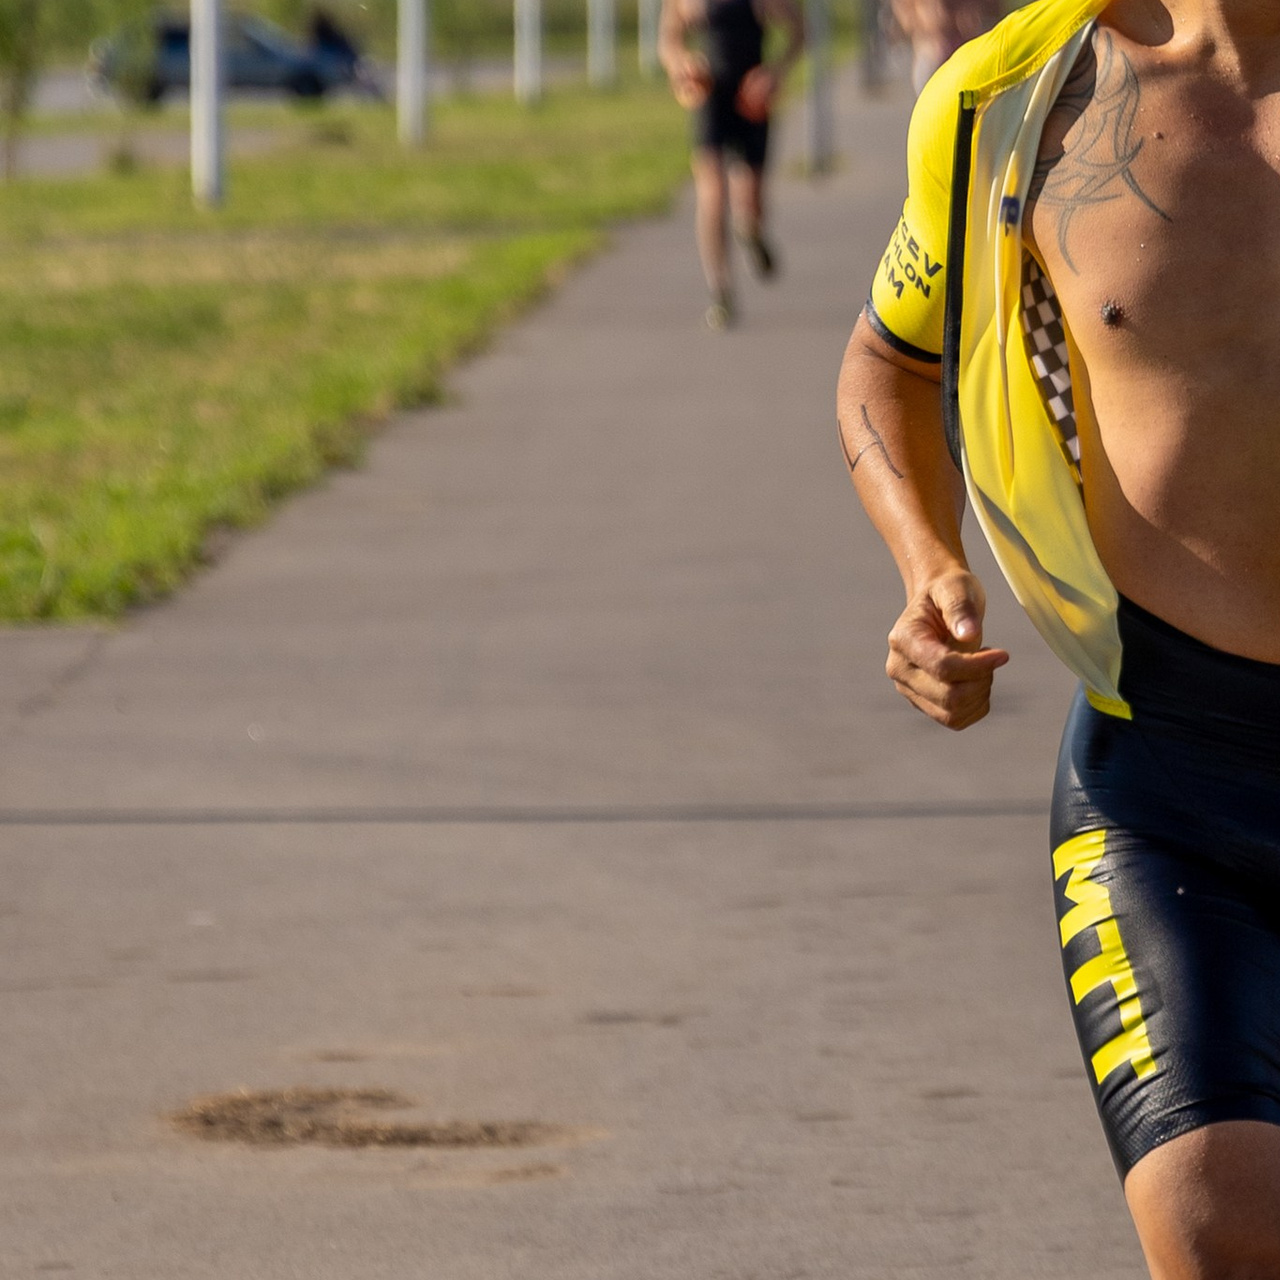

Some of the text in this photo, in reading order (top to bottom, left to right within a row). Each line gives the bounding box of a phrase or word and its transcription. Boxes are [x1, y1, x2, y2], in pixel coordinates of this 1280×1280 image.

[884, 253, 905, 300] AM
[901, 212, 943, 278] CEV
[1052, 829, 1158, 1085] MTT
